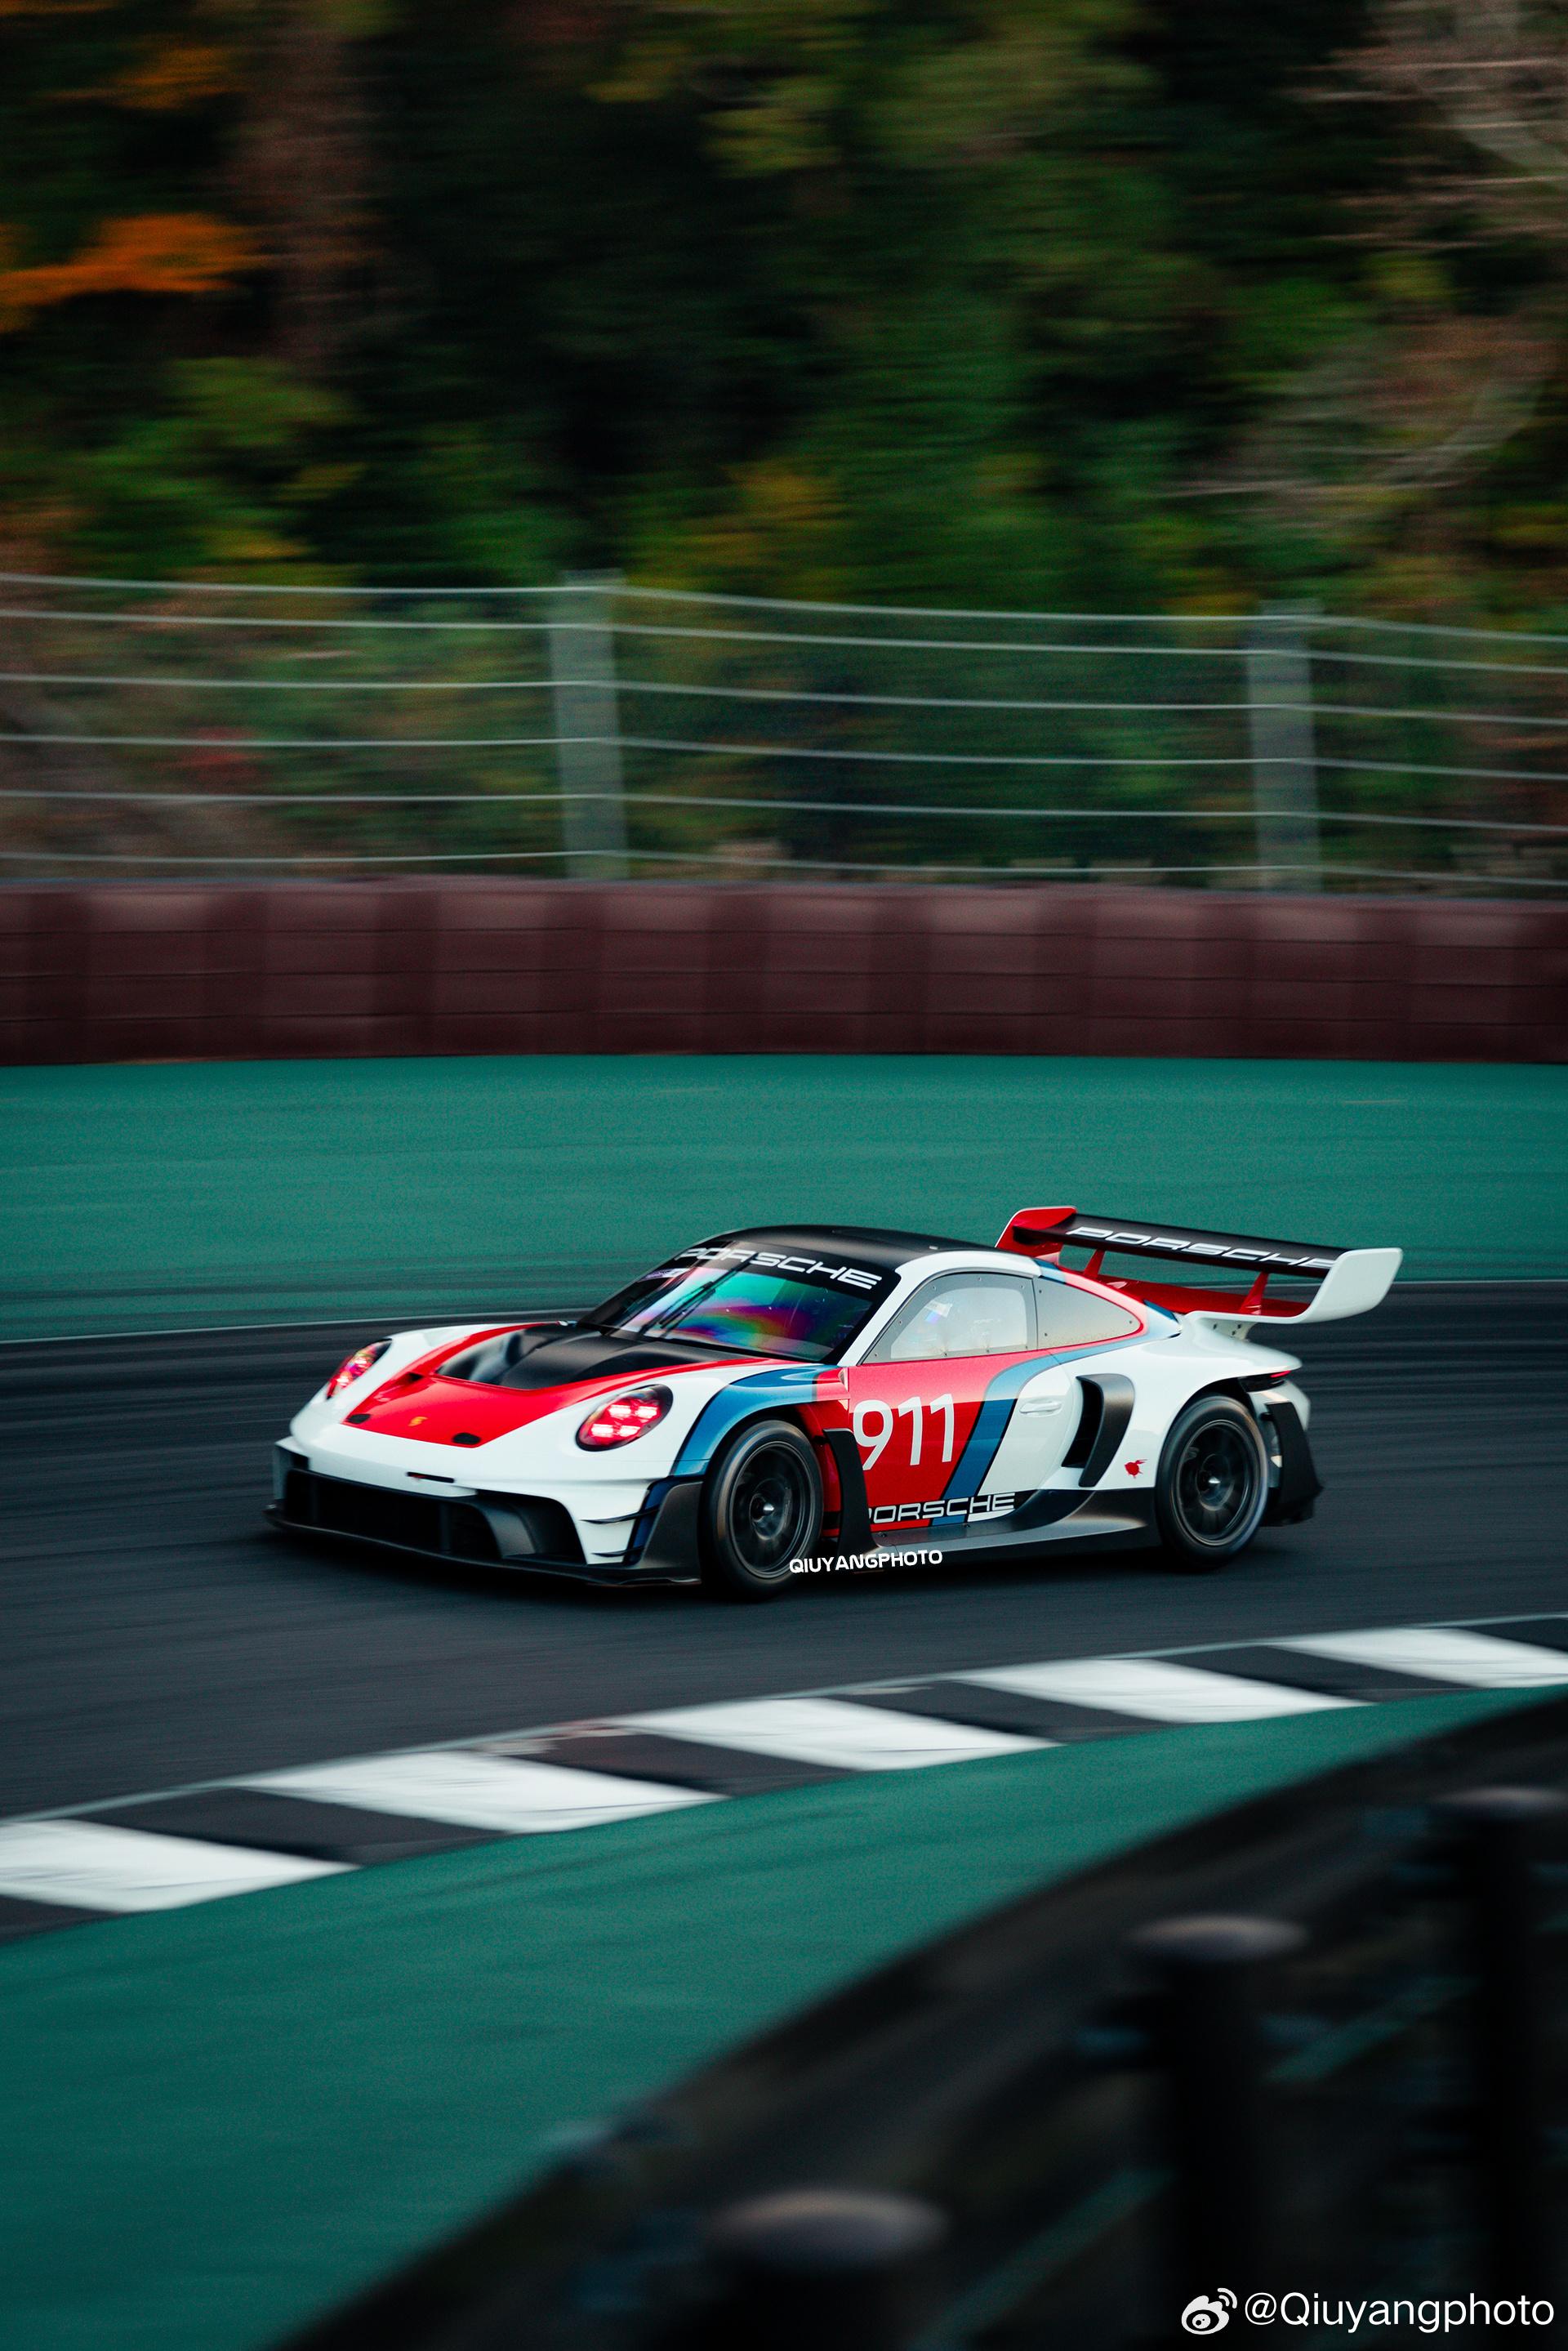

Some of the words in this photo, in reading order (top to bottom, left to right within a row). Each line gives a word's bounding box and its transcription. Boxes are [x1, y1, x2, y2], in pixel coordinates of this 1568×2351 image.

[674, 1247, 882, 1289] PORSCHE
[1065, 1226, 1338, 1269] PORSCHE
[853, 1394, 955, 1470] 911
[868, 1492, 1015, 1523] ORSCHE
